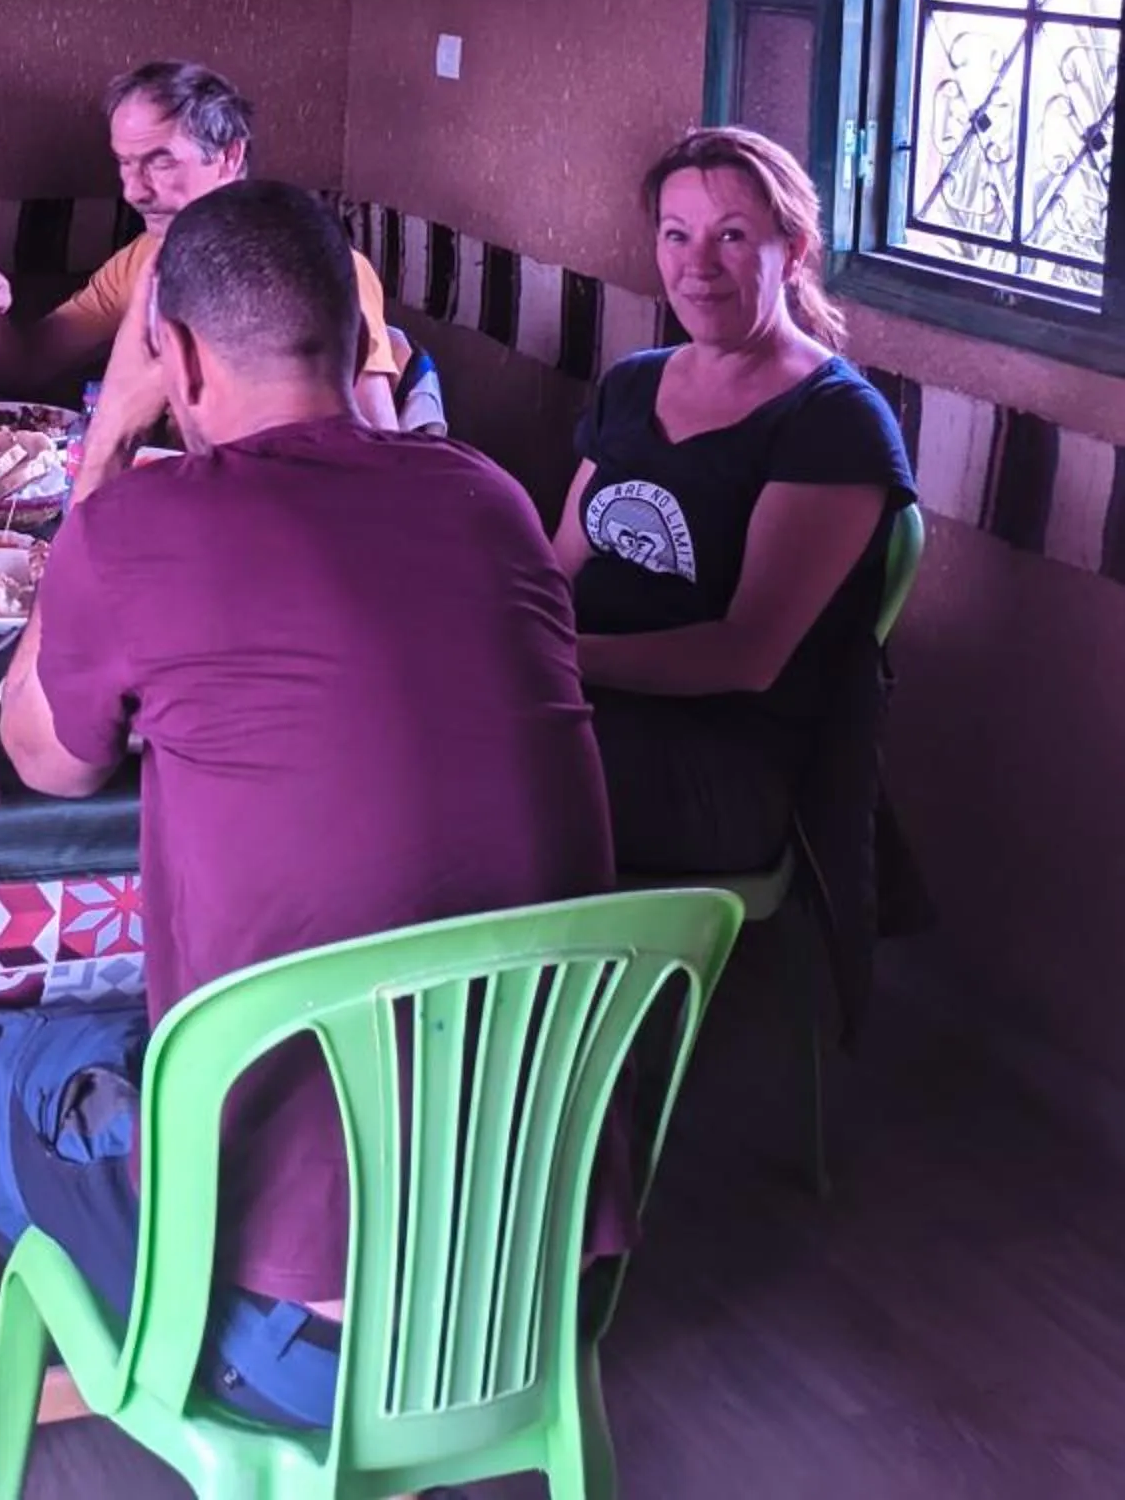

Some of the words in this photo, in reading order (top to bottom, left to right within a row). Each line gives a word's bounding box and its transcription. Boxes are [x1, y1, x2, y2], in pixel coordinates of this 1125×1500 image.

[588, 493, 606, 546] ERE
[614, 483, 647, 497] ARE
[650, 488, 670, 509] NO
